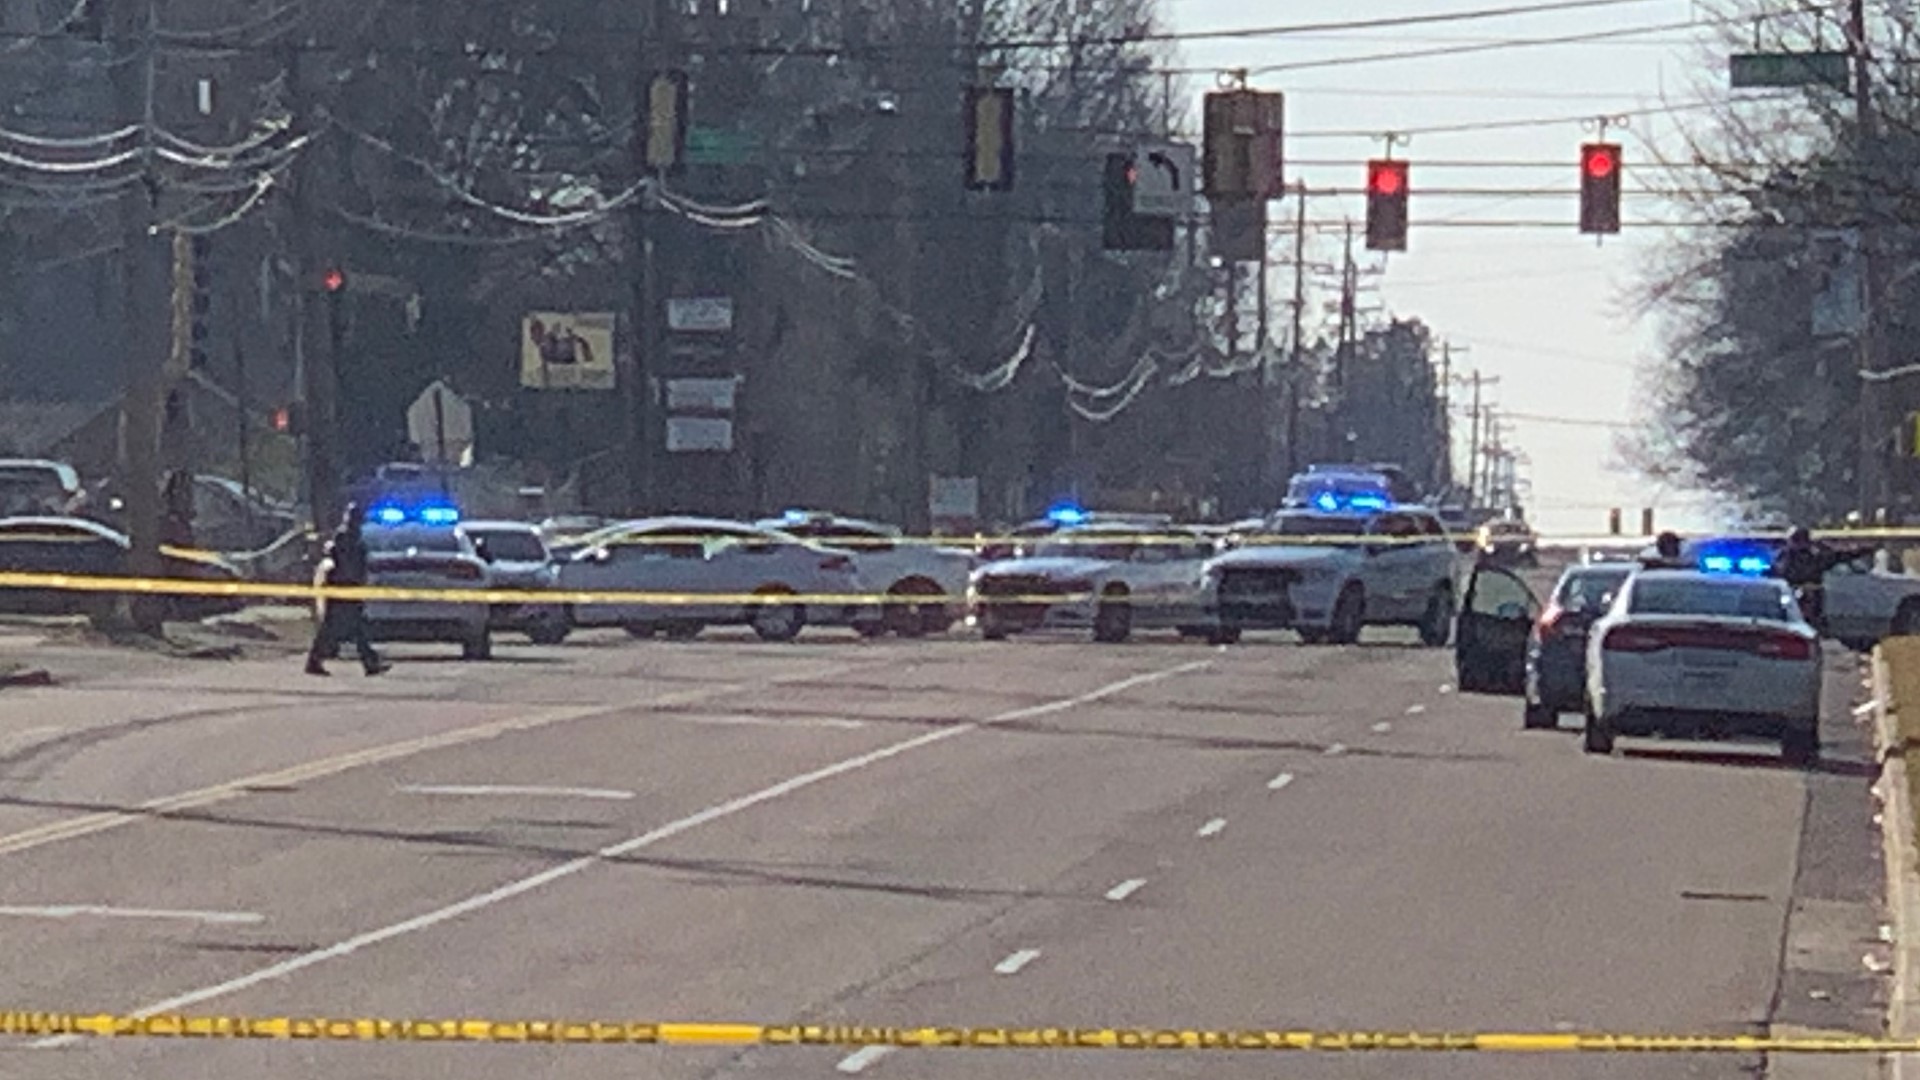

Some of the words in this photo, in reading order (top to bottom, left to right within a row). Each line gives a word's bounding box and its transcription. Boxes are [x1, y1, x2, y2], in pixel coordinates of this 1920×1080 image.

[114, 1014, 278, 1037] SCENE
[290, 1018, 352, 1039] DO
[490, 1020, 658, 1044] CROSS
[936, 1028, 1101, 1047] SCENE
[1117, 1029, 1185, 1049] DO
